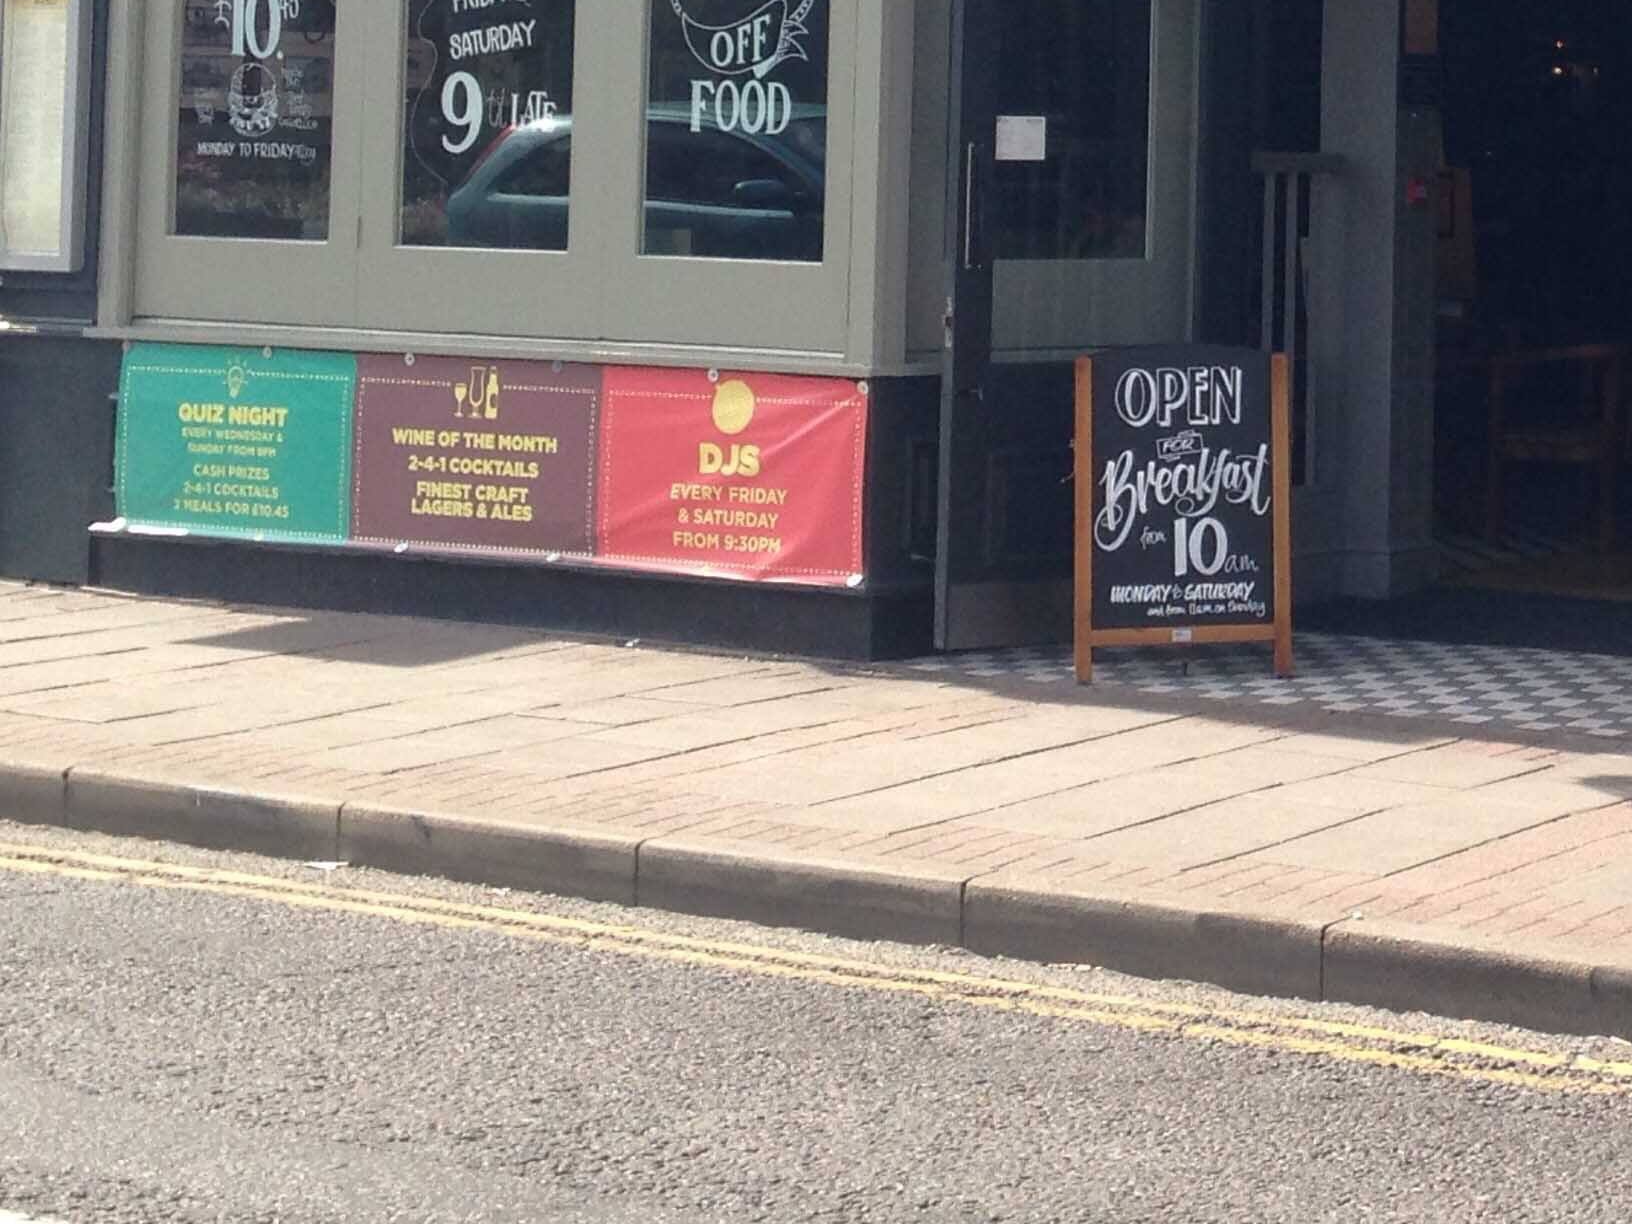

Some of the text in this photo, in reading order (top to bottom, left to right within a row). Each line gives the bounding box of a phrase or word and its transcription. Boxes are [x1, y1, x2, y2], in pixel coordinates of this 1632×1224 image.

[450, 19, 536, 61] SATURDAY
[710, 12, 772, 68] OFF
[441, 70, 484, 155] 9
[688, 78, 793, 135] FOOD
[239, 142, 252, 157] TO
[253, 142, 294, 160] FRIDAY
[1115, 366, 1243, 427] OPEN
[178, 402, 289, 428] QUIZ NIGHT
[391, 427, 558, 453] WINE OF THE MONTH
[1160, 437, 1195, 455] FOR
[408, 455, 540, 479] 2-4-1 COCKTAILS
[698, 441, 762, 477] DJS
[193, 463, 270, 481] CASH PRIZES
[213, 483, 279, 499] COCKTAILS
[416, 480, 529, 504] FINEST CRAFT
[670, 482, 788, 506] EVERY FRIDAY
[1094, 443, 1272, 552] Breakfast
[182, 500, 222, 513] MEALS
[224, 502, 250, 515] FOR
[411, 498, 533, 522] LAGERS & ALES
[677, 507, 779, 529] & SATURDAY
[672, 531, 782, 553] FROM 9:30PM
[1110, 583, 1172, 604] MONDAY
[1183, 580, 1255, 602] SATURDAY
